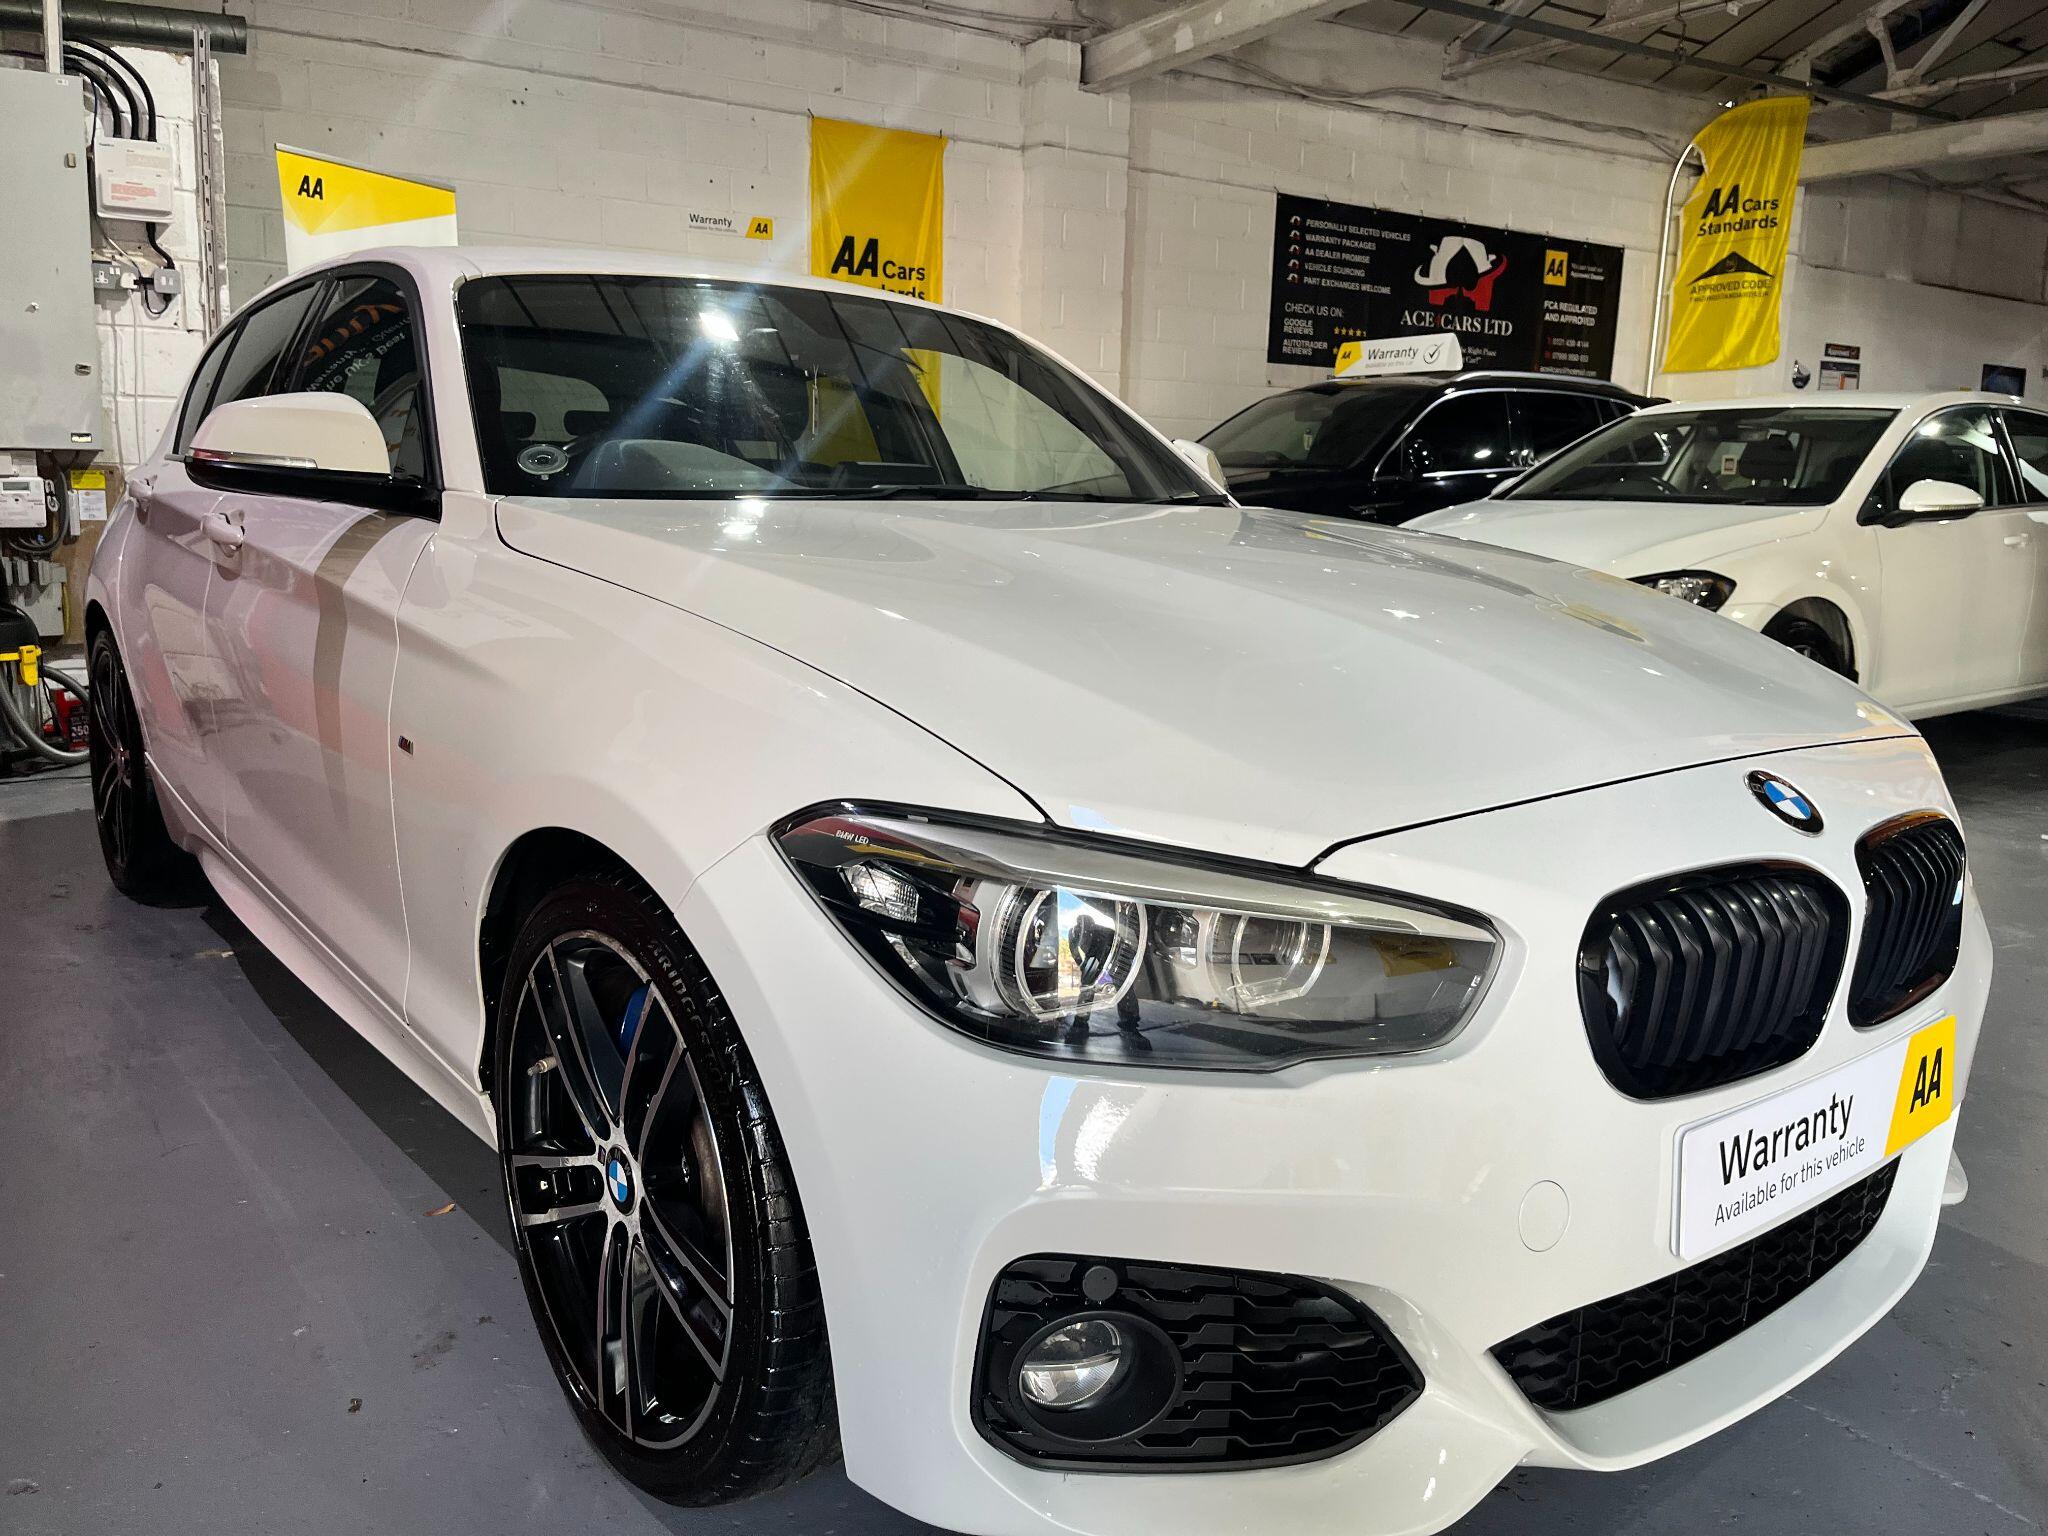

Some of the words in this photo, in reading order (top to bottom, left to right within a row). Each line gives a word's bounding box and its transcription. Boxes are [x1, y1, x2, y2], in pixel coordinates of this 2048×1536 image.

[298, 175, 323, 200] AA
[1701, 184, 1740, 219] AA
[1742, 198, 1780, 213] Cars
[689, 213, 732, 228] Warranty
[754, 222, 768, 234] AA
[1305, 219, 1347, 232] PERSONALLY
[1348, 224, 1381, 236] SELECTED
[1381, 230, 1412, 241] VEHICLES
[1697, 215, 1778, 237] Standards
[1305, 233, 1340, 246] WARRANTY
[1342, 239, 1377, 250] PACKAGES
[831, 235, 879, 277] AA
[882, 260, 926, 281] Cars
[1305, 248, 1314, 256] AA
[1316, 249, 1340, 260] DEALER
[1342, 253, 1370, 263] PROMISE
[1304, 262, 1331, 273] VEHICLE
[1333, 266, 1365, 277] SOURCING
[1546, 258, 1564, 277] AA
[1303, 276, 1320, 286] PART
[1321, 279, 1360, 291] EXCHANGES
[1361, 284, 1391, 295] WELCOME
[1284, 302, 1317, 316] CHECK
[1316, 306, 1329, 317] US
[1544, 300, 1558, 310] FCA
[1560, 302, 1598, 315] REGULATED
[1284, 317, 1313, 328] GOOGLE
[1484, 318, 1513, 337] LTD
[1544, 313, 1559, 322] AND
[1560, 314, 1596, 327] APPROVED
[1283, 325, 1314, 336] REVIEWS
[1282, 346, 1313, 356] REVIEWS
[1283, 338, 1328, 350] AUTOTRADER
[1368, 346, 1419, 360] Warranty
[836, 830, 854, 841] BMW
[855, 835, 869, 844] LED
[1719, 1092, 1854, 1186] Warranty
[1909, 1046, 1943, 1115] AA
[1714, 1181, 1777, 1227] Available
[1780, 1171, 1798, 1194] for
[1801, 1158, 1823, 1184] this
[1825, 1136, 1865, 1170] vehicle
